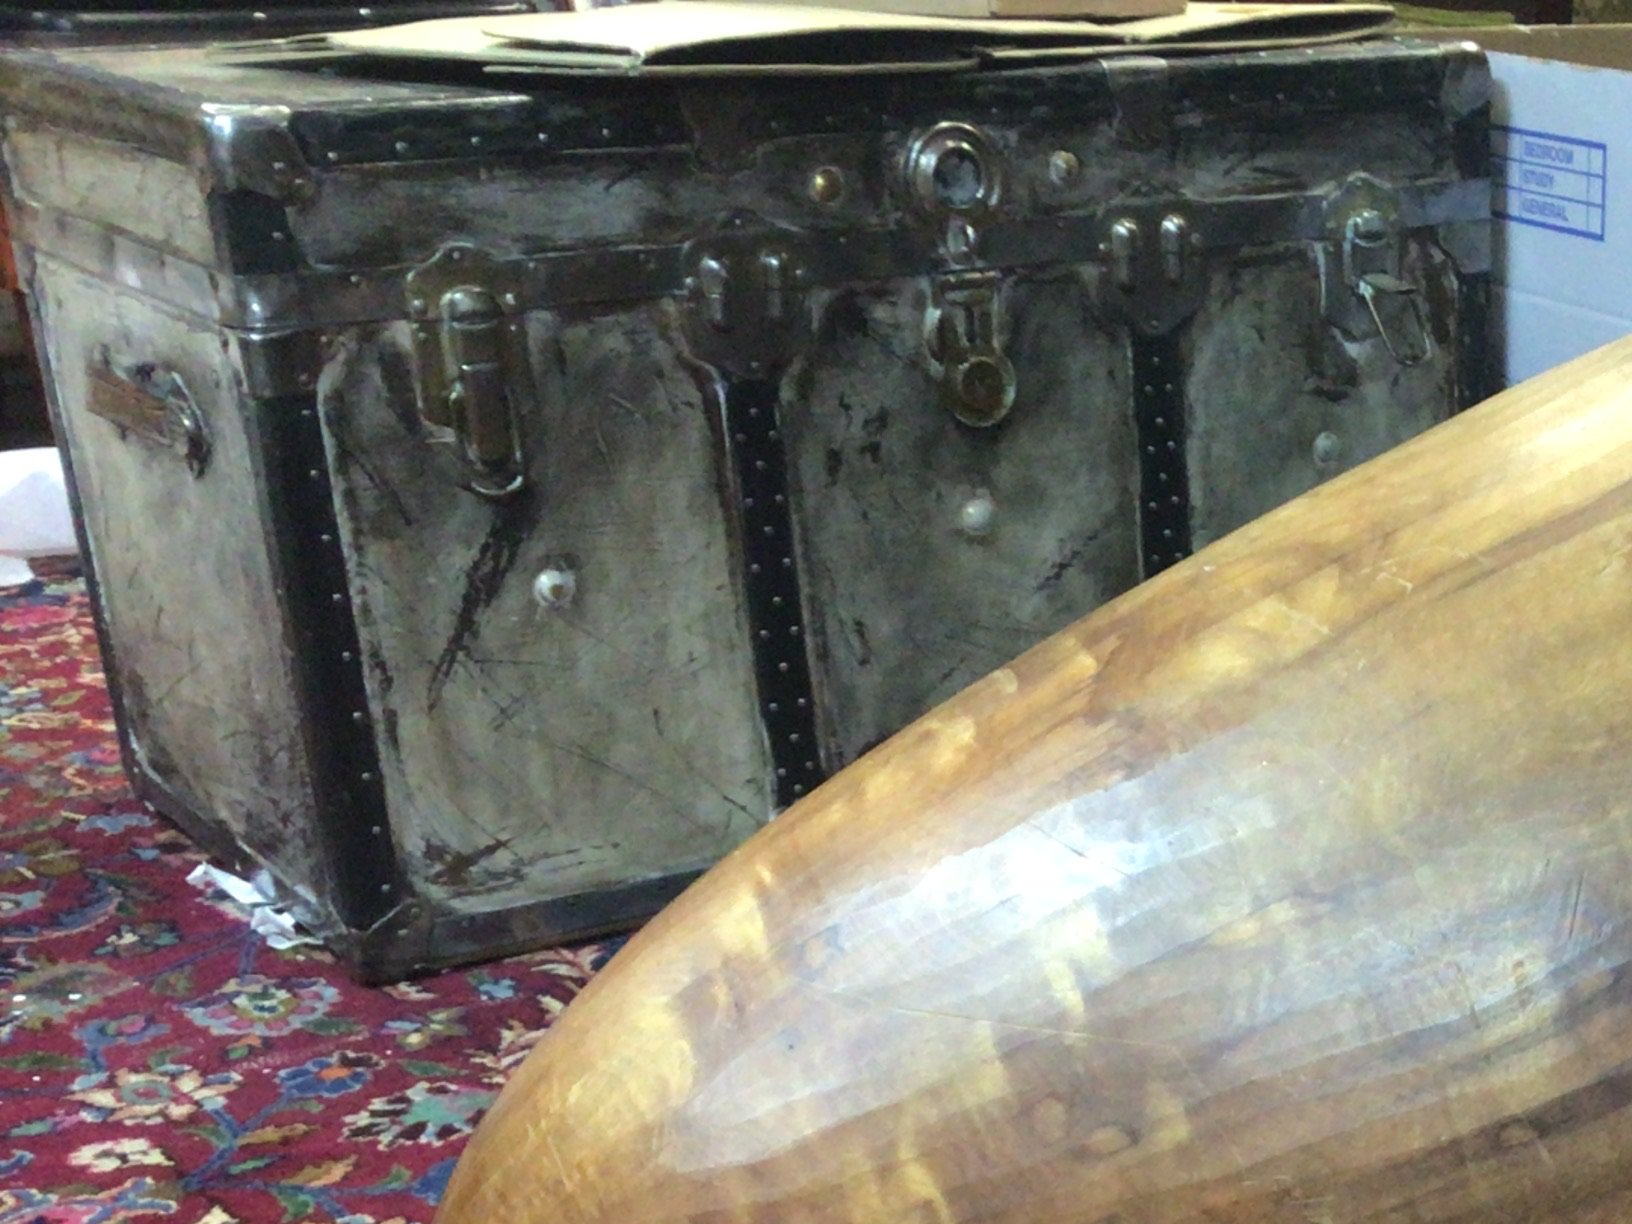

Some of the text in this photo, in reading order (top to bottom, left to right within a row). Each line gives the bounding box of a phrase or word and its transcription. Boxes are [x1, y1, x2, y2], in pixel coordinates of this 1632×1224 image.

[1524, 140, 1574, 165] BEDROOM
[1522, 169, 1554, 189] STUDY
[1521, 197, 1569, 222] GENERAL
